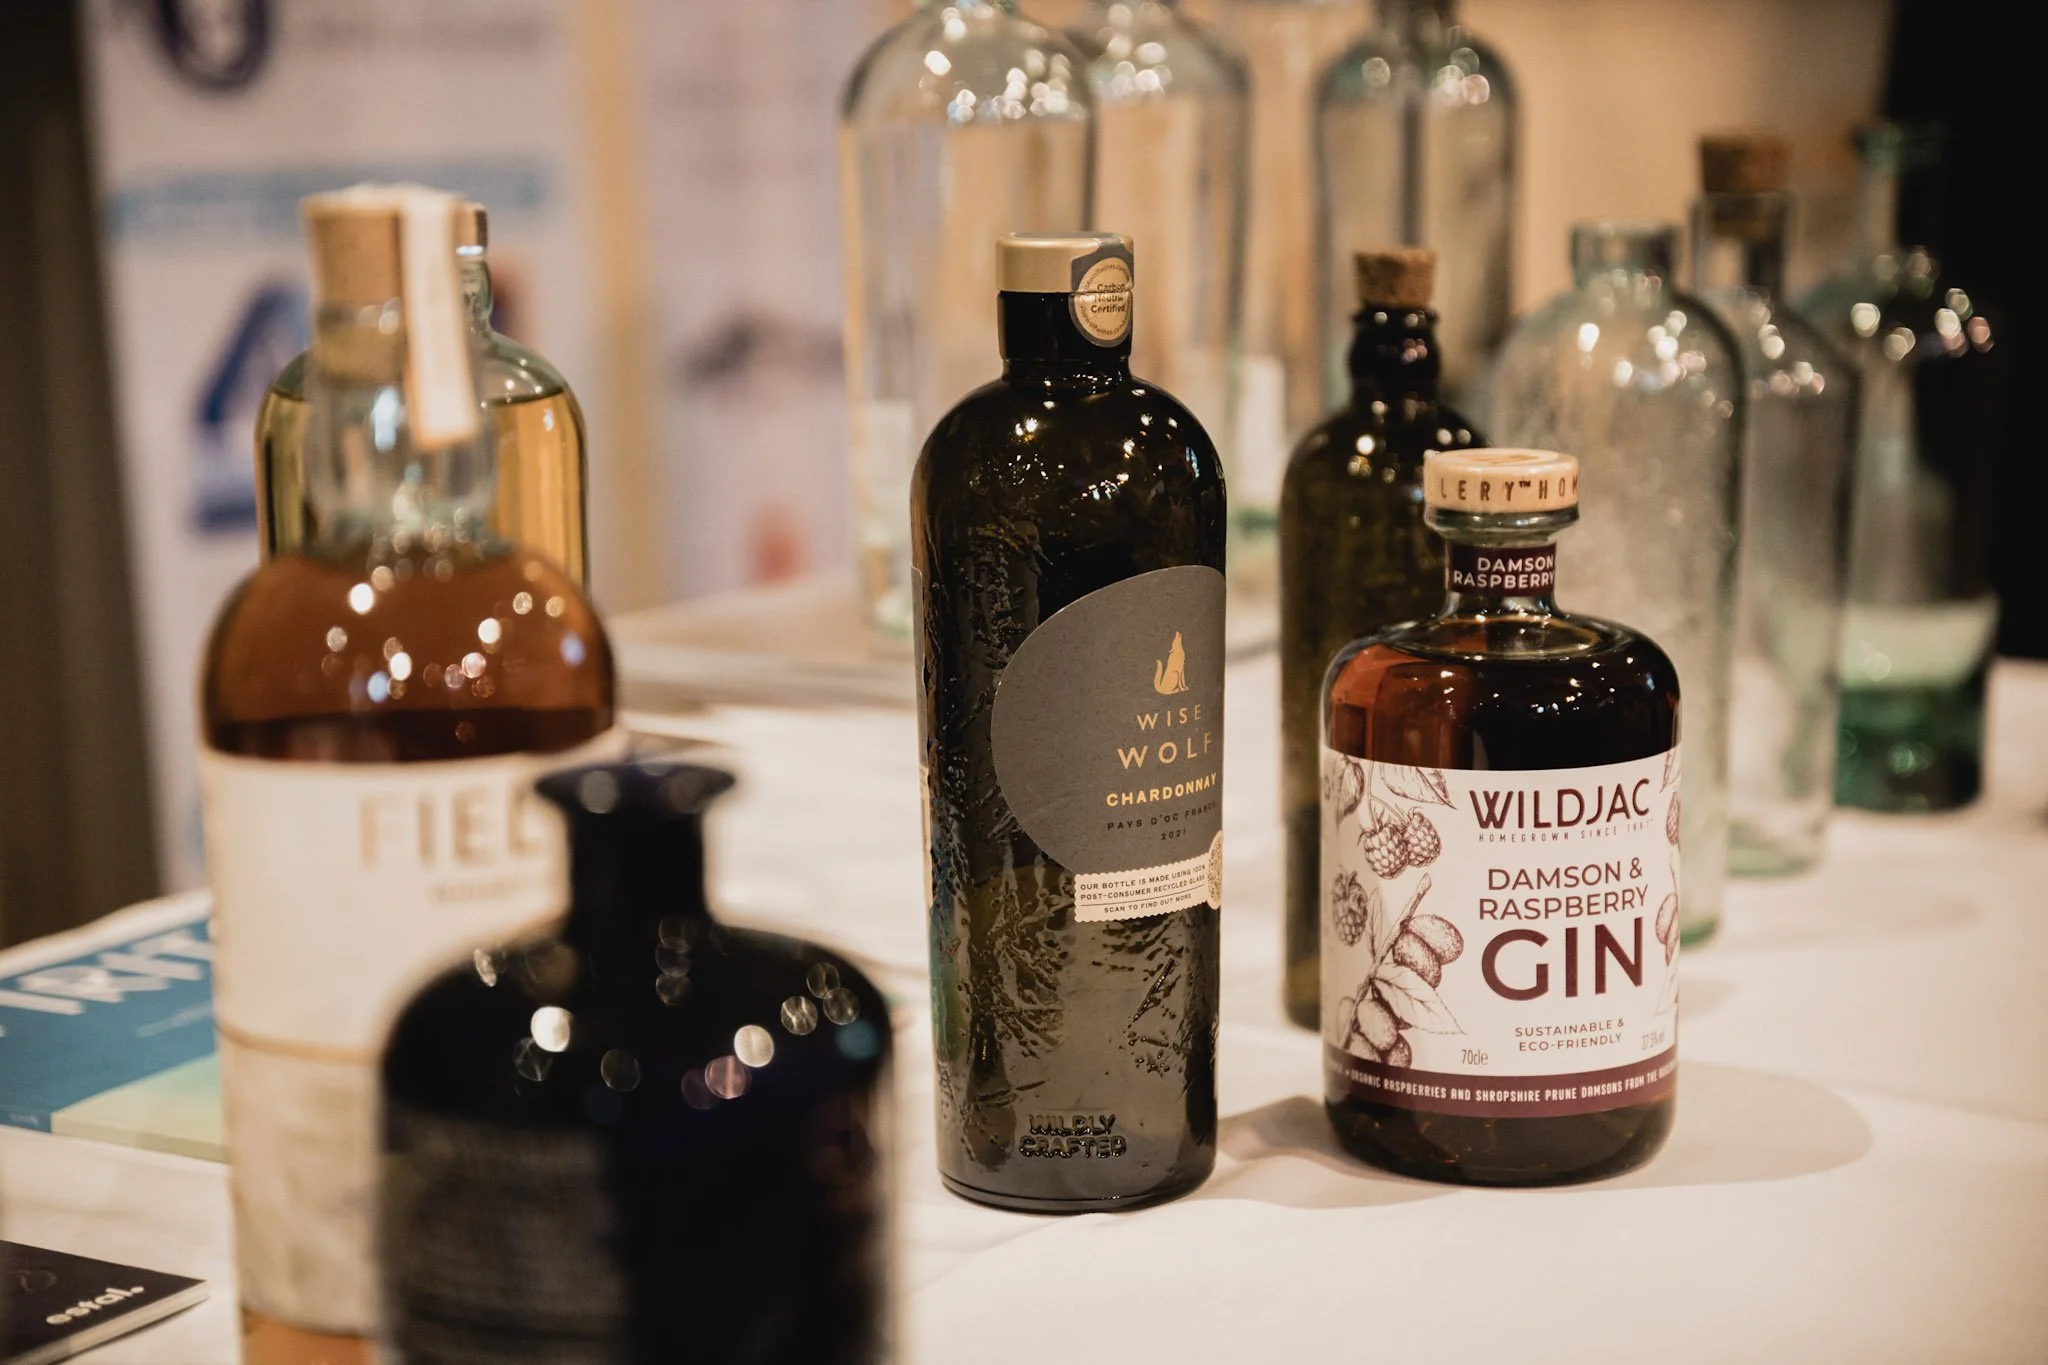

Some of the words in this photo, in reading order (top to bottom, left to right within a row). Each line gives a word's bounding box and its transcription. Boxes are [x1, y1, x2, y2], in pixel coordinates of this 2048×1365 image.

[1097, 283, 1125, 293] Carbon
[1091, 303, 1126, 313] Certified
[1477, 555, 1554, 573] DAMSON
[1453, 571, 1555, 589] RASPBERRY
[1136, 704, 1201, 731] WISE
[1117, 732, 1212, 770] WOLF
[1106, 772, 1217, 807] CHARDONNAY
[1469, 778, 1650, 829] WILDJAC
[1107, 819, 1143, 831] PAYS
[1150, 813, 1179, 826] D'OC
[1161, 828, 1187, 840] 2021
[1479, 832, 1570, 843] HOMEGROWN
[1580, 826, 1617, 839] SINCE
[1080, 883, 1099, 891] OUR
[1102, 879, 1136, 890] BOTTLE
[1149, 874, 1170, 884] MADE
[1171, 869, 1191, 880] USING
[1488, 861, 1621, 891] DAMSON
[1629, 857, 1643, 879] &
[1080, 887, 1151, 901] POST-CONSUMER
[1153, 881, 1187, 893] RECYCLED
[1189, 874, 1206, 885] GLASS
[1104, 905, 1125, 914] SCAN
[1140, 901, 1157, 910] FIND
[1160, 898, 1173, 906] OUT
[1175, 893, 1192, 902] MORE
[1479, 884, 1649, 921] RASPBERRY
[1481, 916, 1643, 1001] GIN
[1515, 1020, 1613, 1037] SUSTAINABLE
[1617, 1017, 1625, 1028] &
[1519, 1032, 1623, 1052] ECO-FRIENDLY
[1351, 1070, 1382, 1088] ORGANIC
[1383, 1078, 1447, 1099] RASPBERRIES
[1451, 1088, 1472, 1101] AND
[1475, 1089, 1541, 1102] SHROPSHIRE
[1545, 1087, 1577, 1101] PRUNE
[1581, 1081, 1623, 1099] DAMSONS
[1625, 1075, 1645, 1091] FROM
[1646, 1069, 1658, 1084] THE
[1028, 1114, 1116, 1136] WILDLY
[1019, 1135, 1127, 1159] CRAFTED
